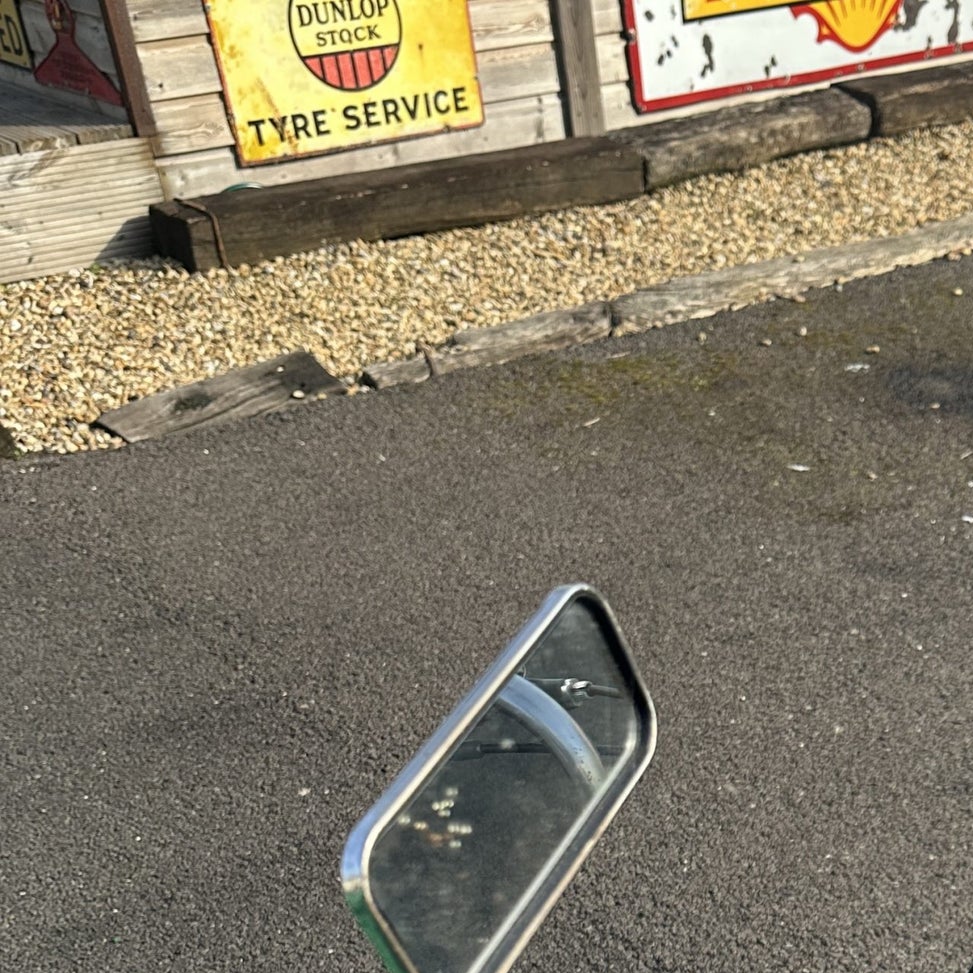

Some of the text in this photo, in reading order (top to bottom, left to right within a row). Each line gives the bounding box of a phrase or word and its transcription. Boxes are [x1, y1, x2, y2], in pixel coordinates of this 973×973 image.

[296, 0, 390, 28] DUNLOP
[315, 24, 382, 47] STOCK
[247, 86, 470, 147] TYRE SERVICE
